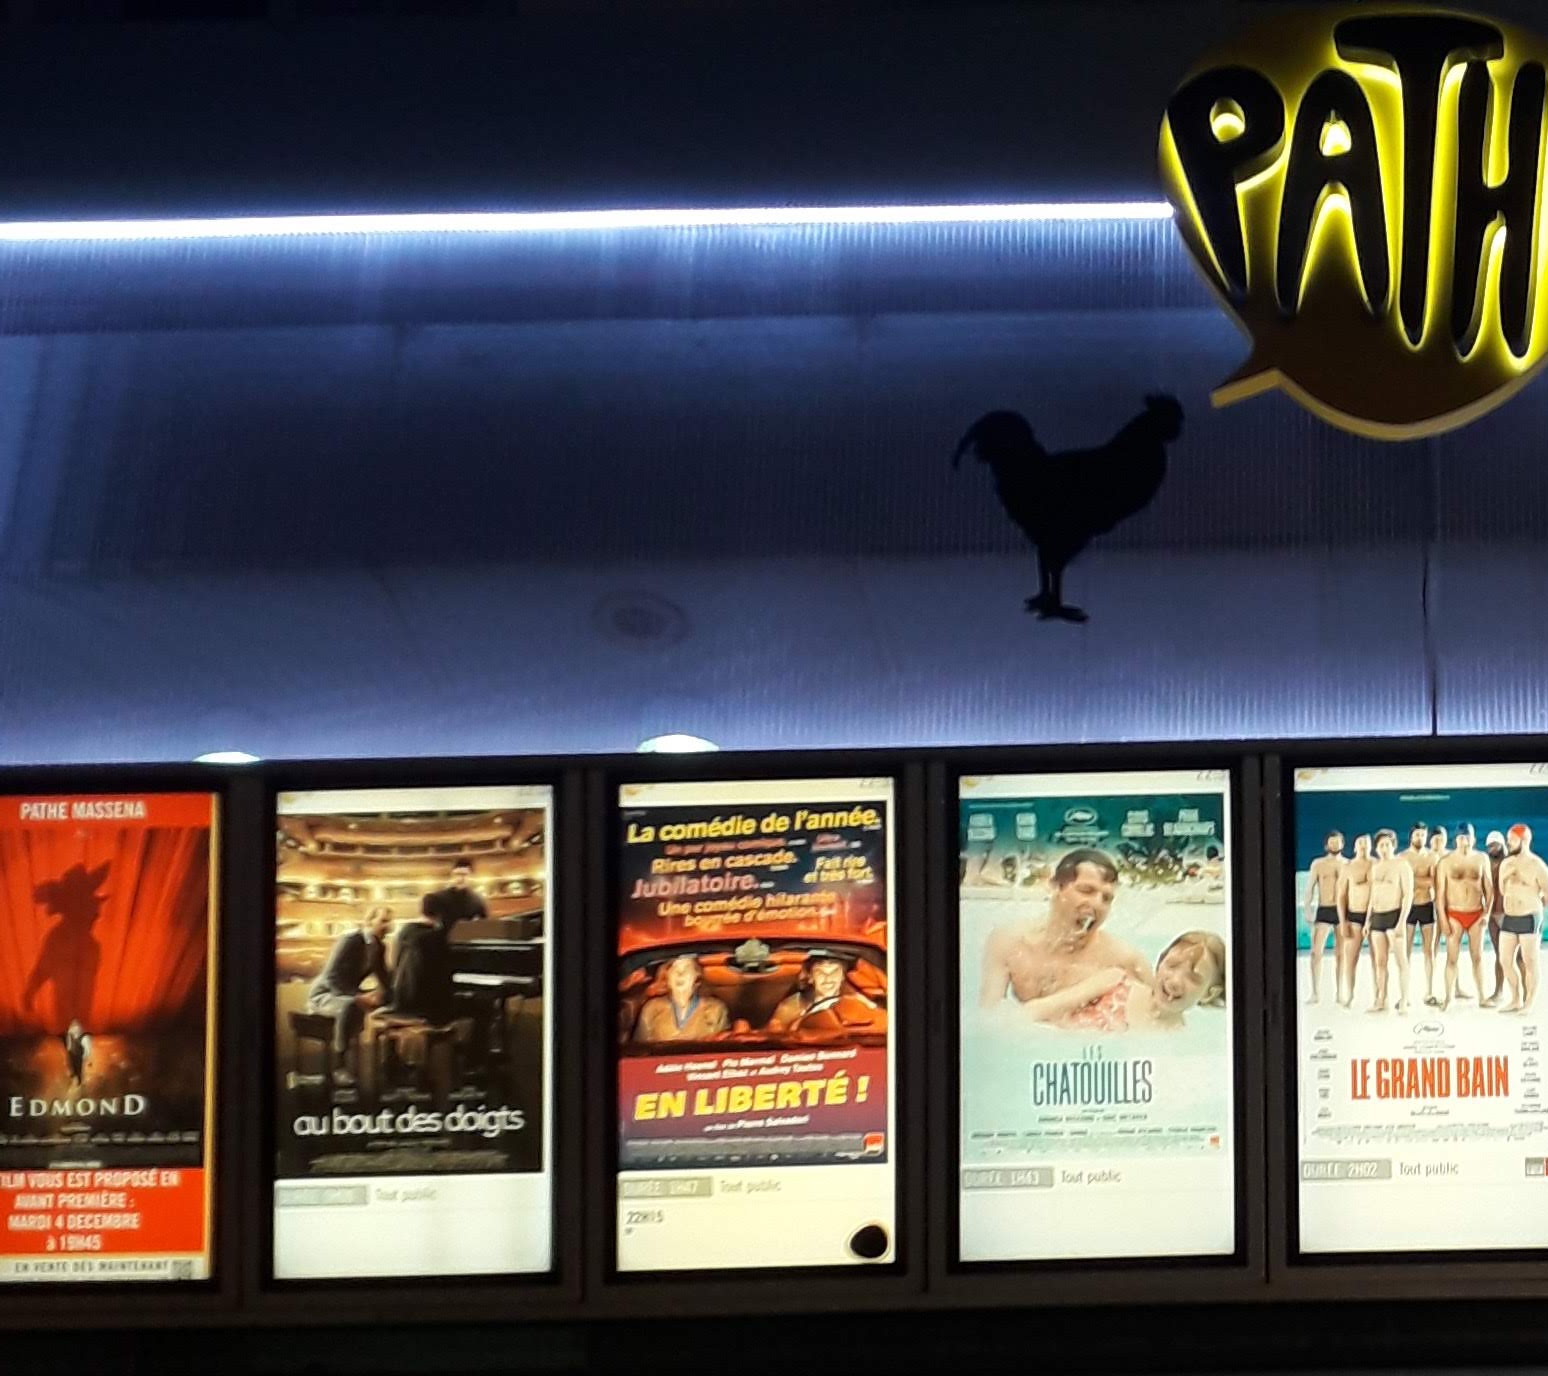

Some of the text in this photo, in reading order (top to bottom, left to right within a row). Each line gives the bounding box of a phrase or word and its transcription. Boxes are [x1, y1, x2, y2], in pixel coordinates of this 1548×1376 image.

[20, 800, 146, 820] PATHE MASSENA
[626, 823, 655, 844] La
[659, 814, 757, 841] comédie
[760, 812, 791, 833] de
[651, 857, 697, 874] Rires
[699, 857, 723, 871] en
[658, 901, 692, 916] Une
[694, 895, 763, 913] comédie
[1033, 1059, 1152, 1106] CHATOUILLES
[1351, 1058, 1371, 1101] LE
[1376, 1055, 1451, 1099] GRAND
[1456, 1054, 1509, 1098] BAIN
[634, 1069, 870, 1120] EN LIBERTÉ !
[9, 1093, 146, 1117] EDMOND
[293, 1104, 527, 1138] au bout des doigts
[1061, 1169, 1121, 1185] Tout public
[1400, 1161, 1459, 1176] Tout public
[67, 1171, 91, 1187] EST
[14, 1193, 54, 1210] AVANT
[8, 1214, 51, 1231] MARDI
